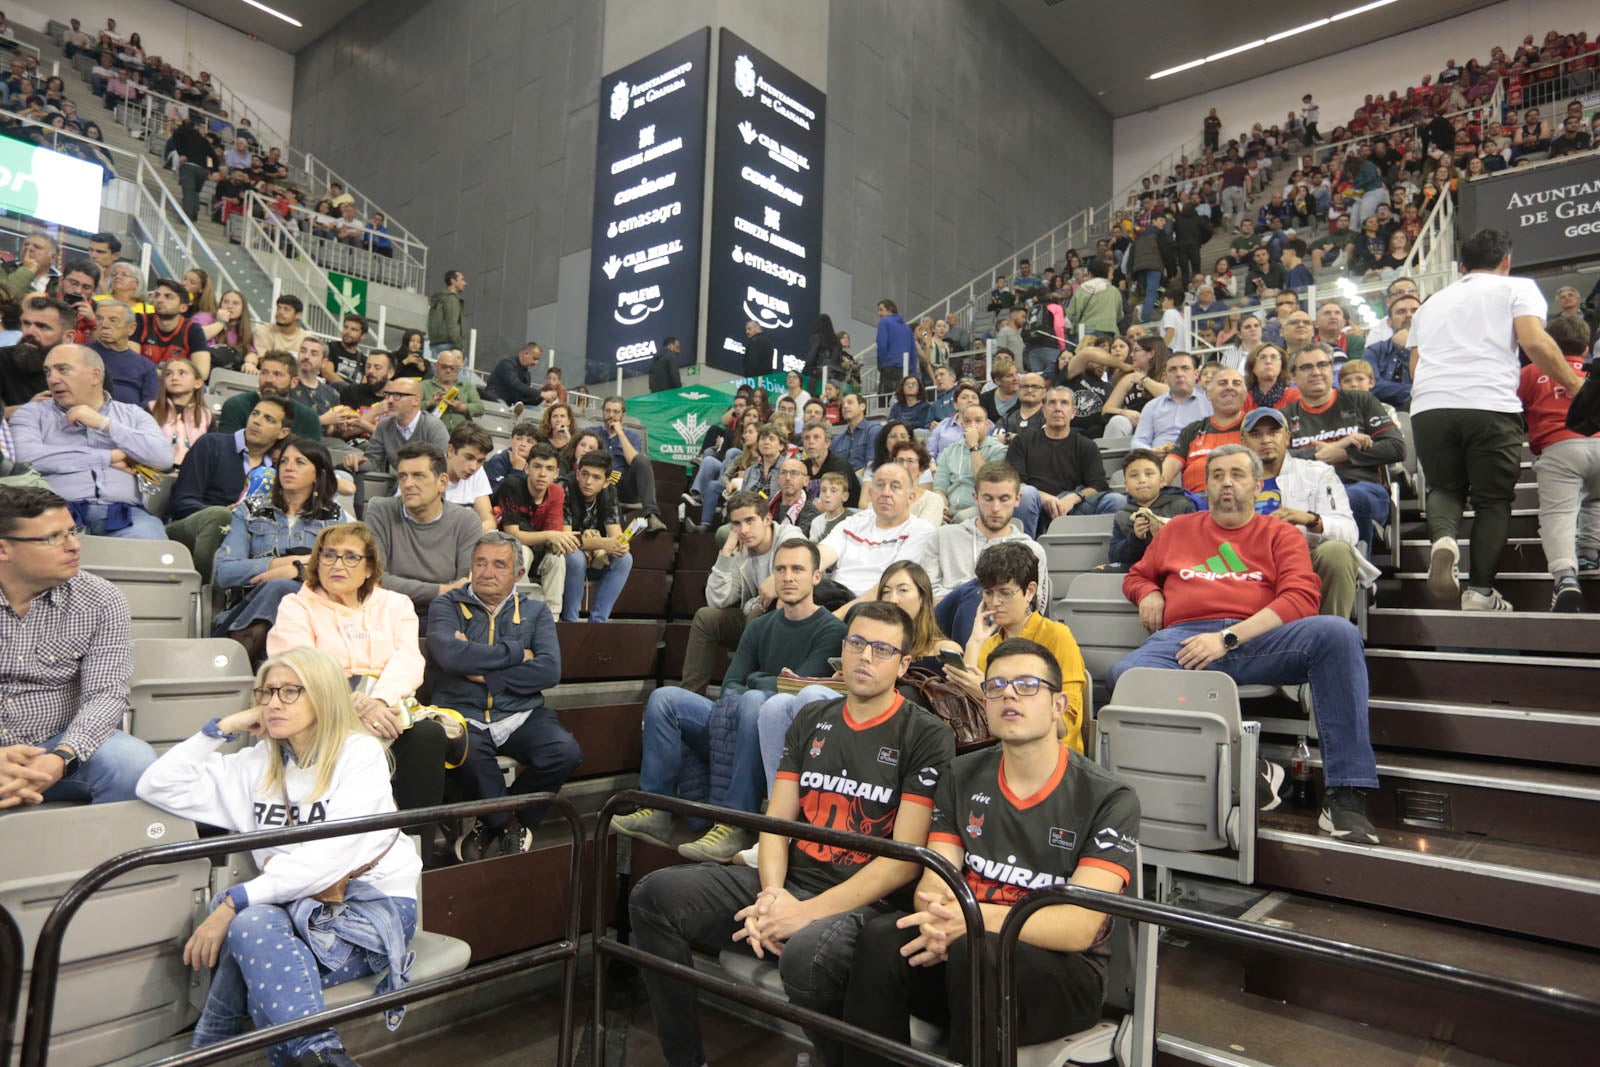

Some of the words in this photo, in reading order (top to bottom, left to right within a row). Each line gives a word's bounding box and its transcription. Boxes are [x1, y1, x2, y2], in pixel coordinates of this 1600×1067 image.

[618, 202, 682, 234] emasagra
[1520, 211, 1549, 227] DE
[744, 251, 806, 288] emasagra
[660, 444, 684, 454] CAJA
